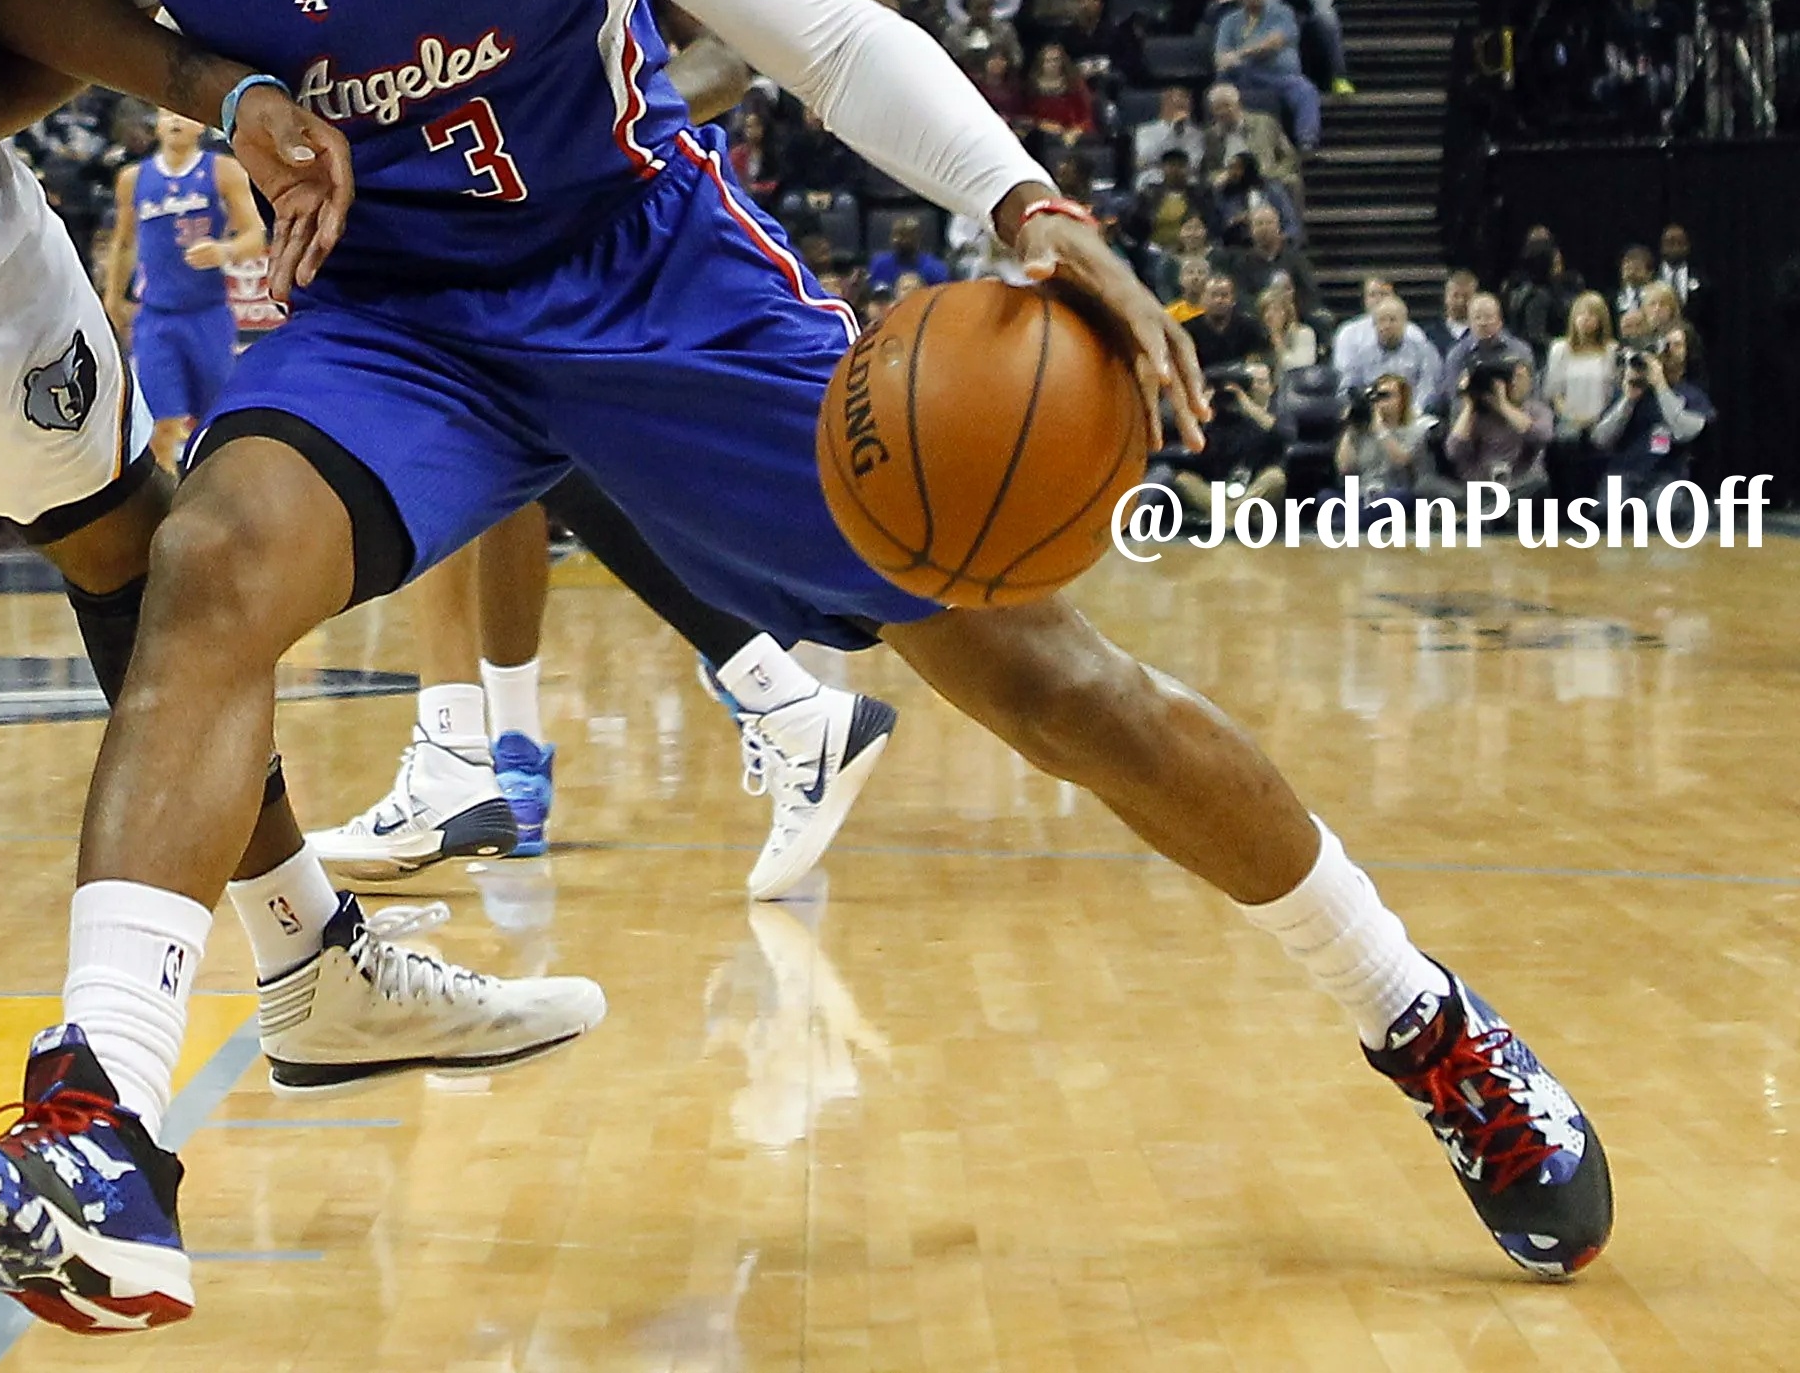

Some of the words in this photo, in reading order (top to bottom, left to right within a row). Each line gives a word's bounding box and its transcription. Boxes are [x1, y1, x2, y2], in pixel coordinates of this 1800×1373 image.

[297, 31, 511, 126] Angeles
[421, 96, 529, 203] 3
[844, 337, 891, 478] LDING
